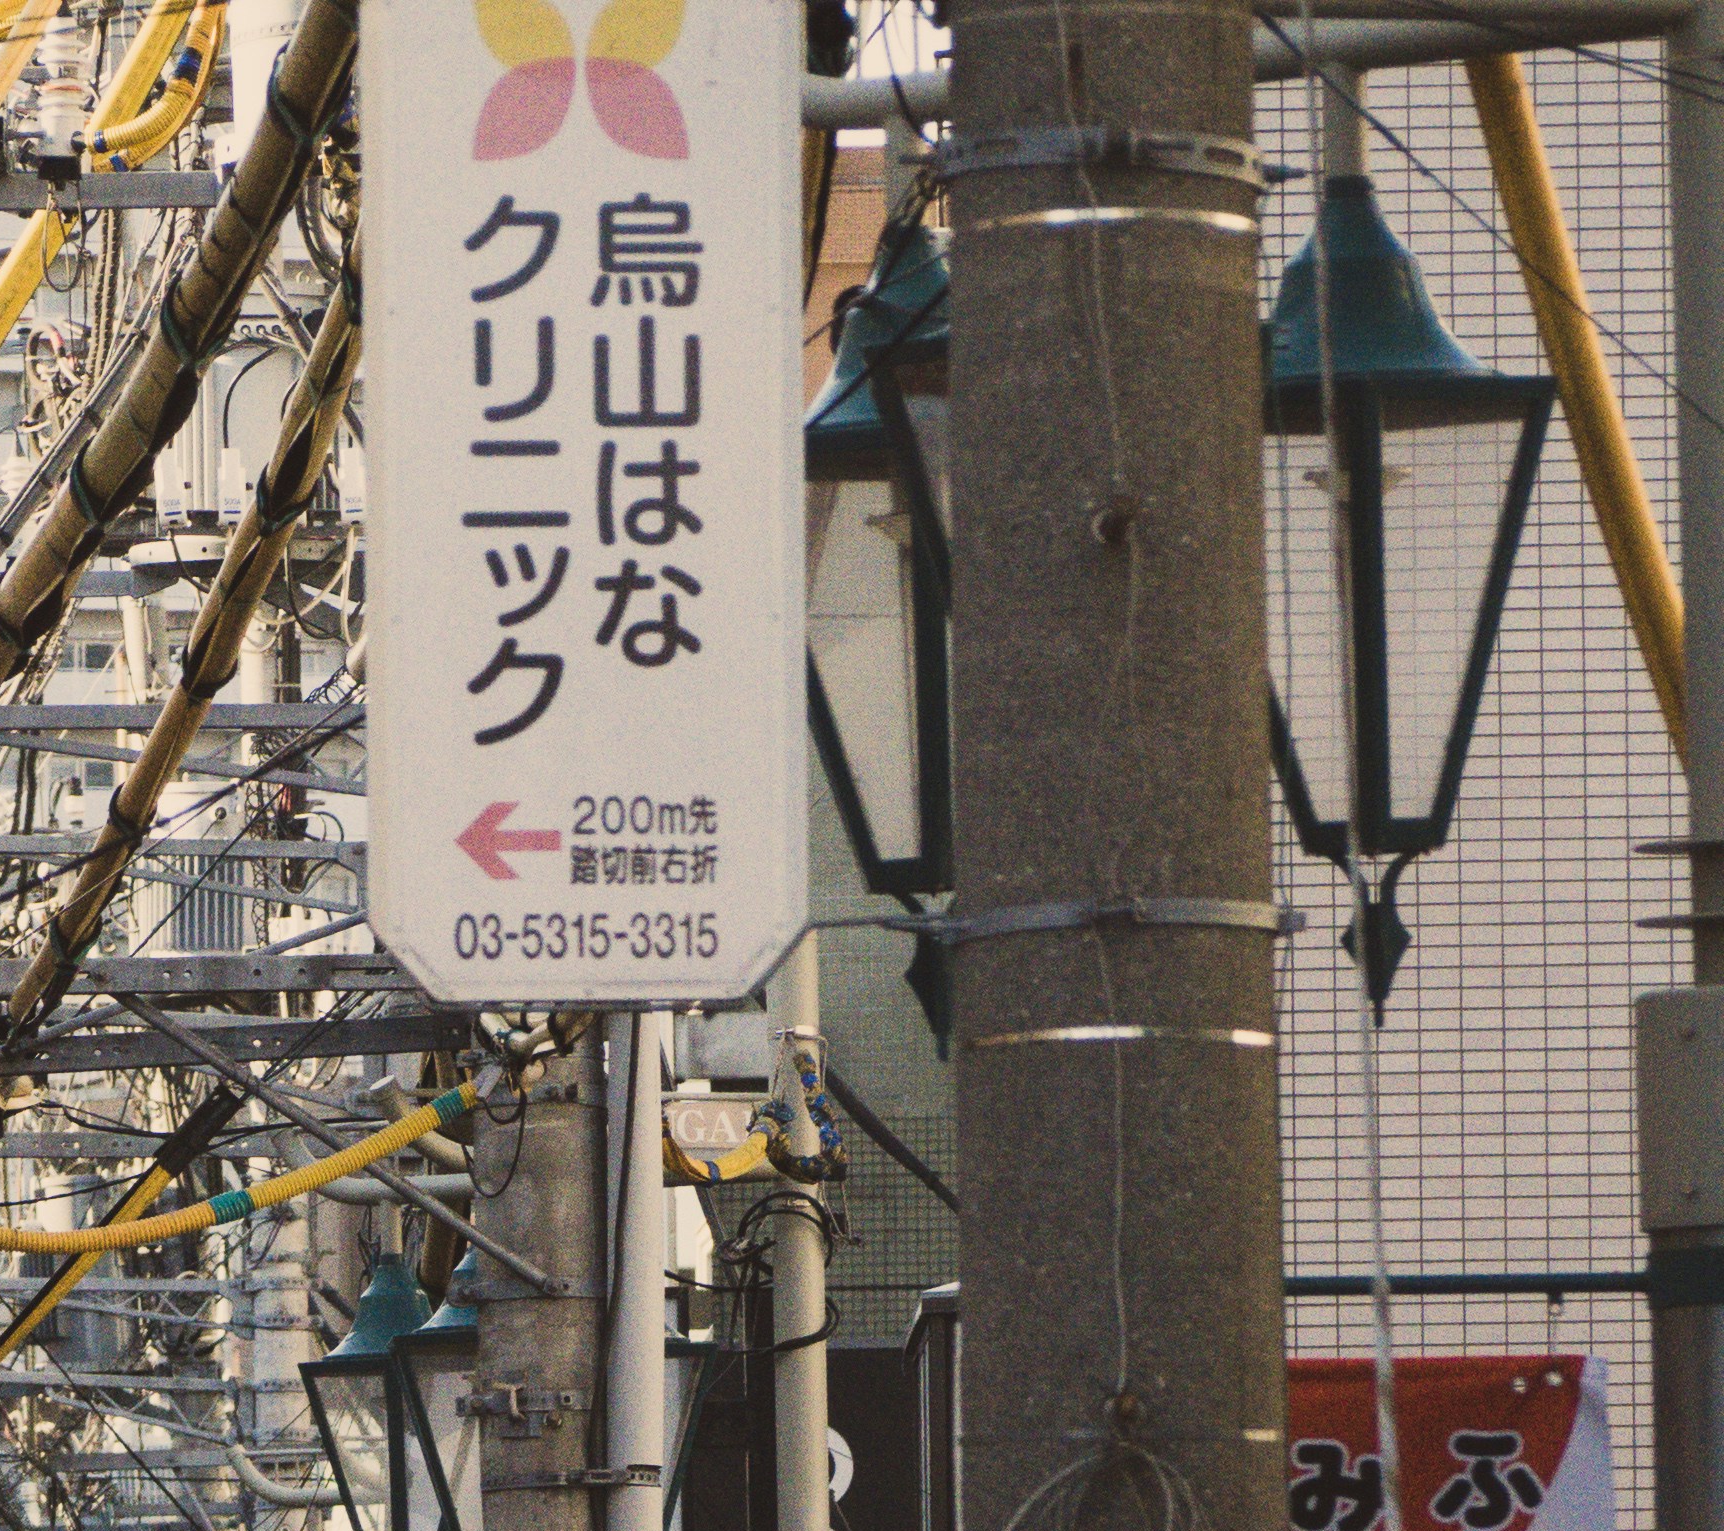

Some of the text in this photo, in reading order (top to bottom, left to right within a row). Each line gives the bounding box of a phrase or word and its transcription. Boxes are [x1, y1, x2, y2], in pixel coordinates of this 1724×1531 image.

[590, 193, 705, 667] 烏山はな
[461, 196, 572, 748] クリニック
[571, 795, 718, 837] 200m先
[569, 845, 718, 886] 踏切前右折
[454, 914, 719, 962] 03-5315-3315
